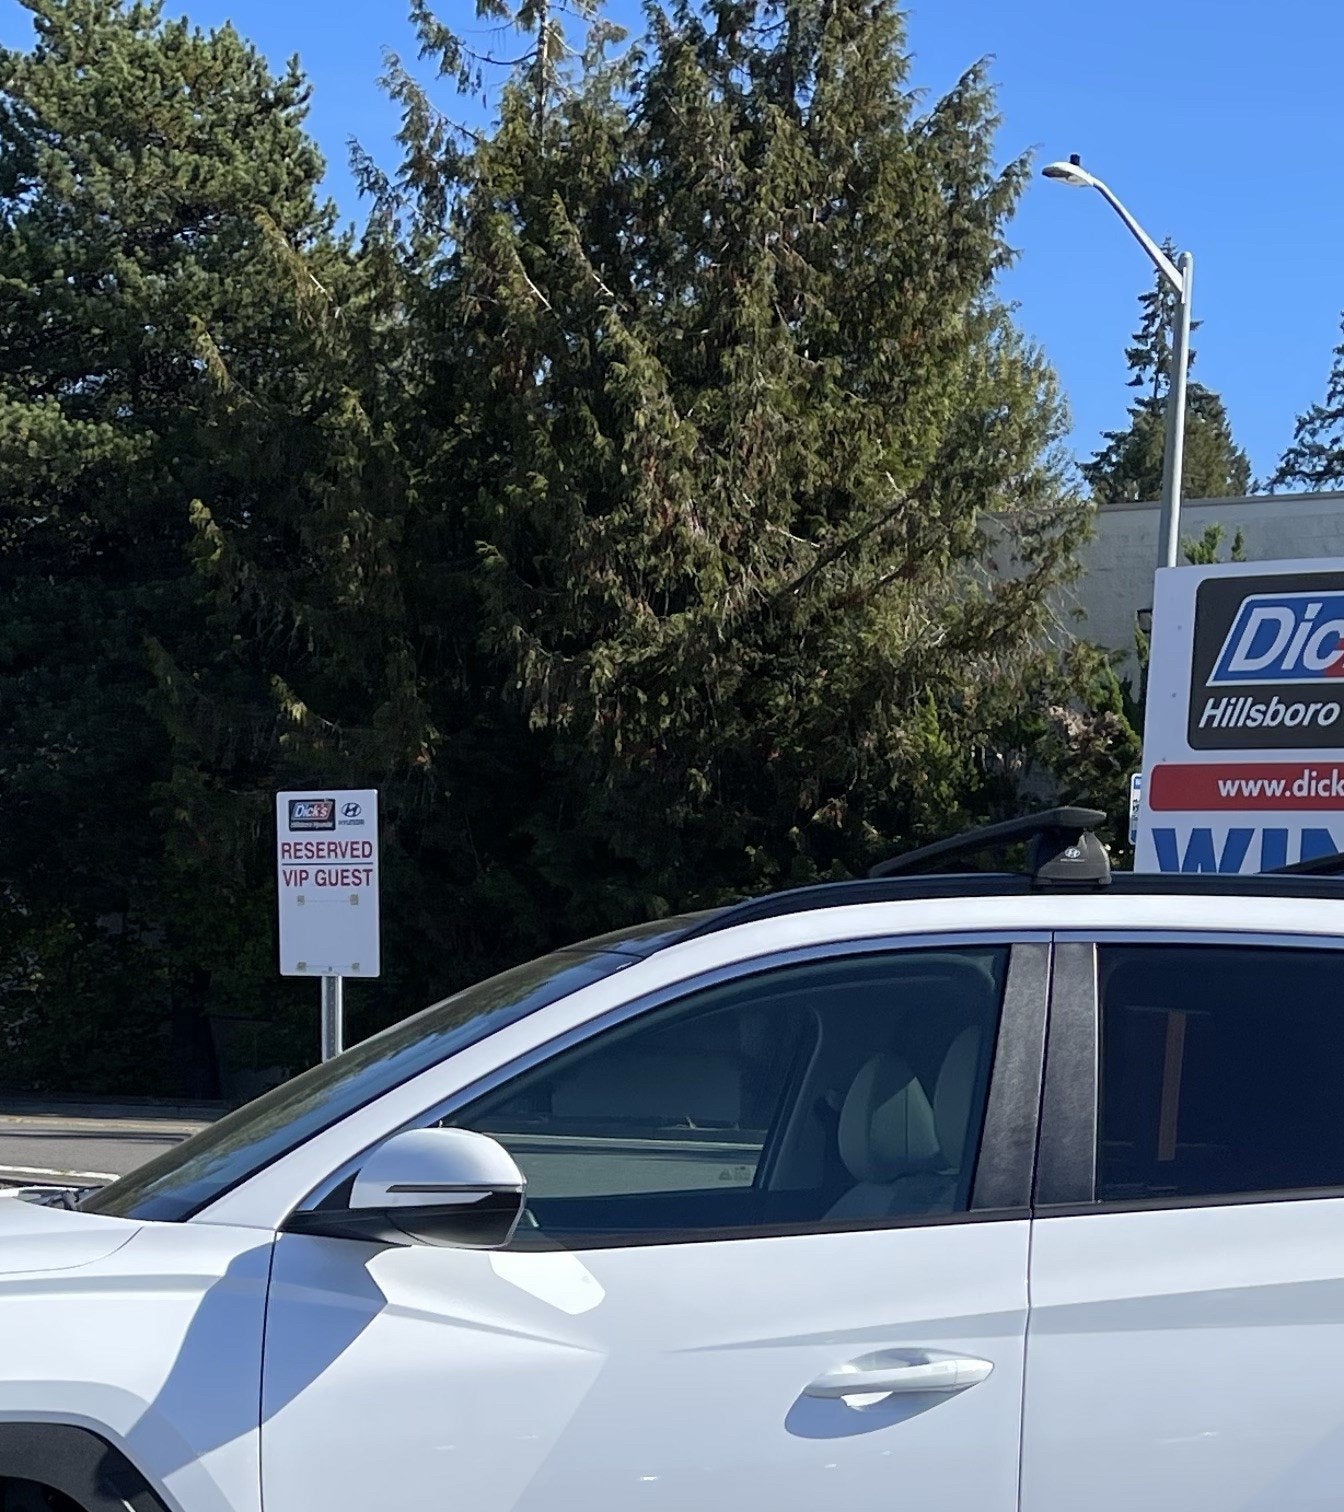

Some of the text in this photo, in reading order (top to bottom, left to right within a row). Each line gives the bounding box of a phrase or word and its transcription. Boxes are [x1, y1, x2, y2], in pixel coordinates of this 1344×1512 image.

[1198, 695, 1341, 729] Hillsboro
[281, 840, 374, 860] RESERVED
[282, 868, 374, 888] VIP GUEST
